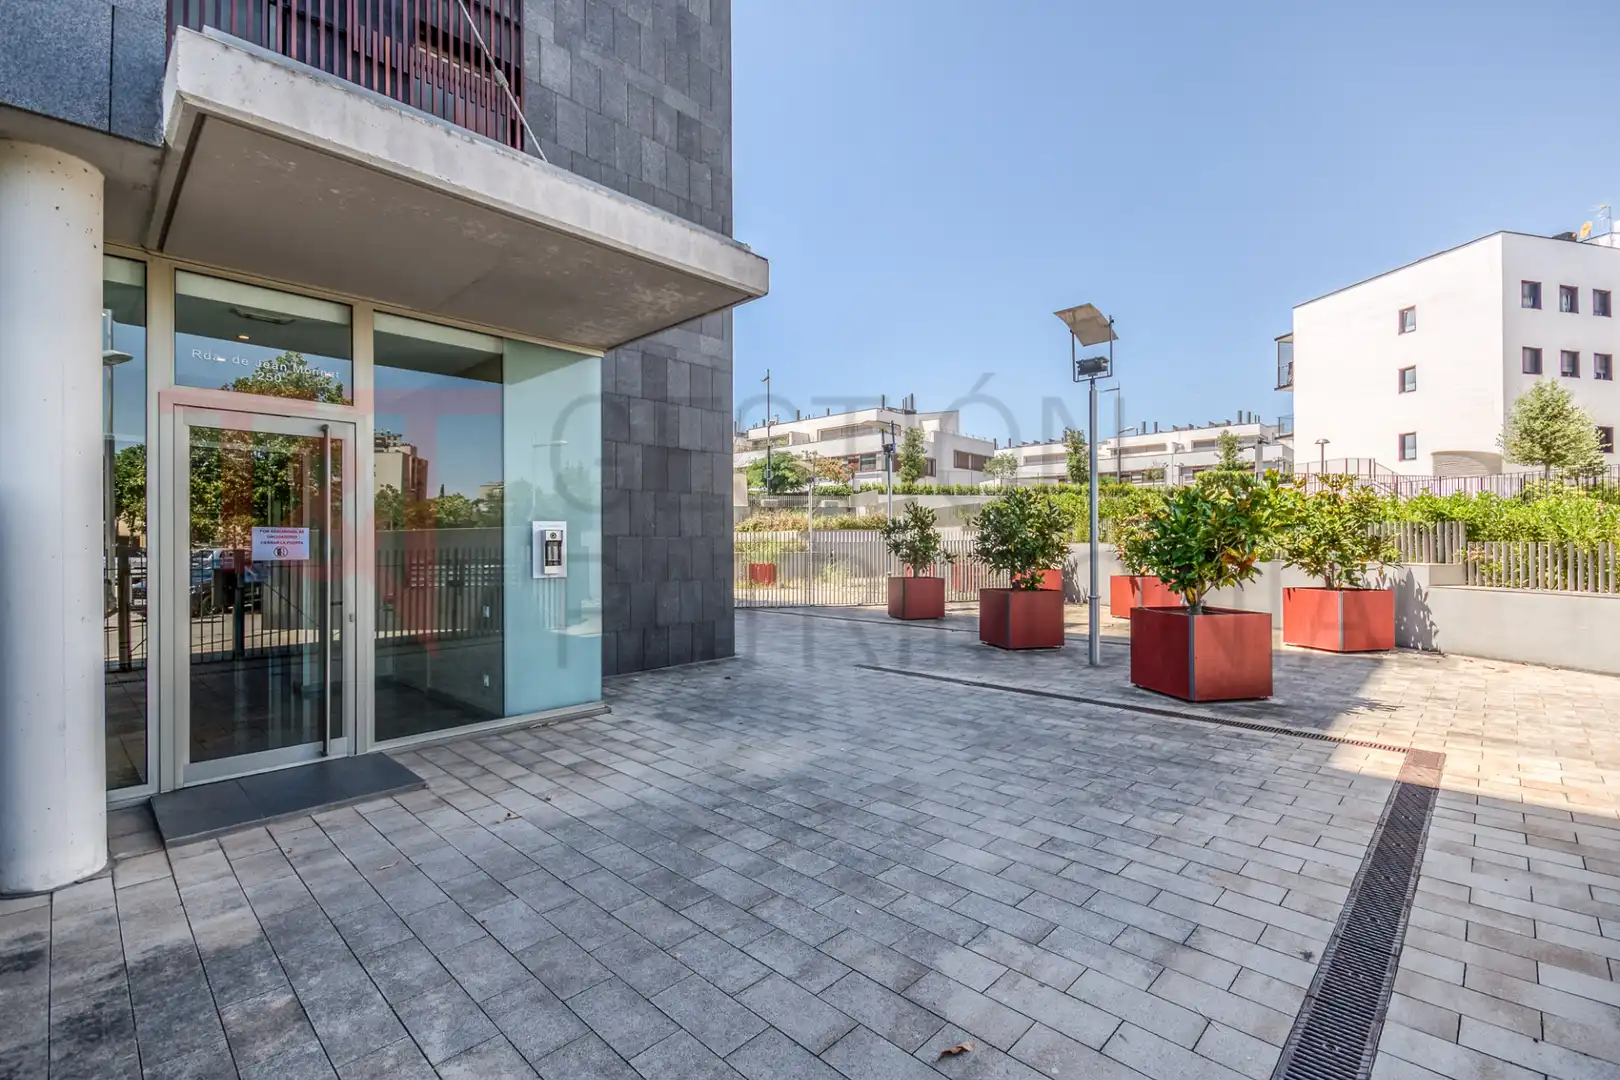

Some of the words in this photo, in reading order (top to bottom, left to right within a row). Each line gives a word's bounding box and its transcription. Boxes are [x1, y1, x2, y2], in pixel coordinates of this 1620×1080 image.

[232, 356, 249, 366] de
[255, 360, 288, 372] Jean
[293, 364, 340, 379] Monnet
[257, 371, 283, 383] 250
